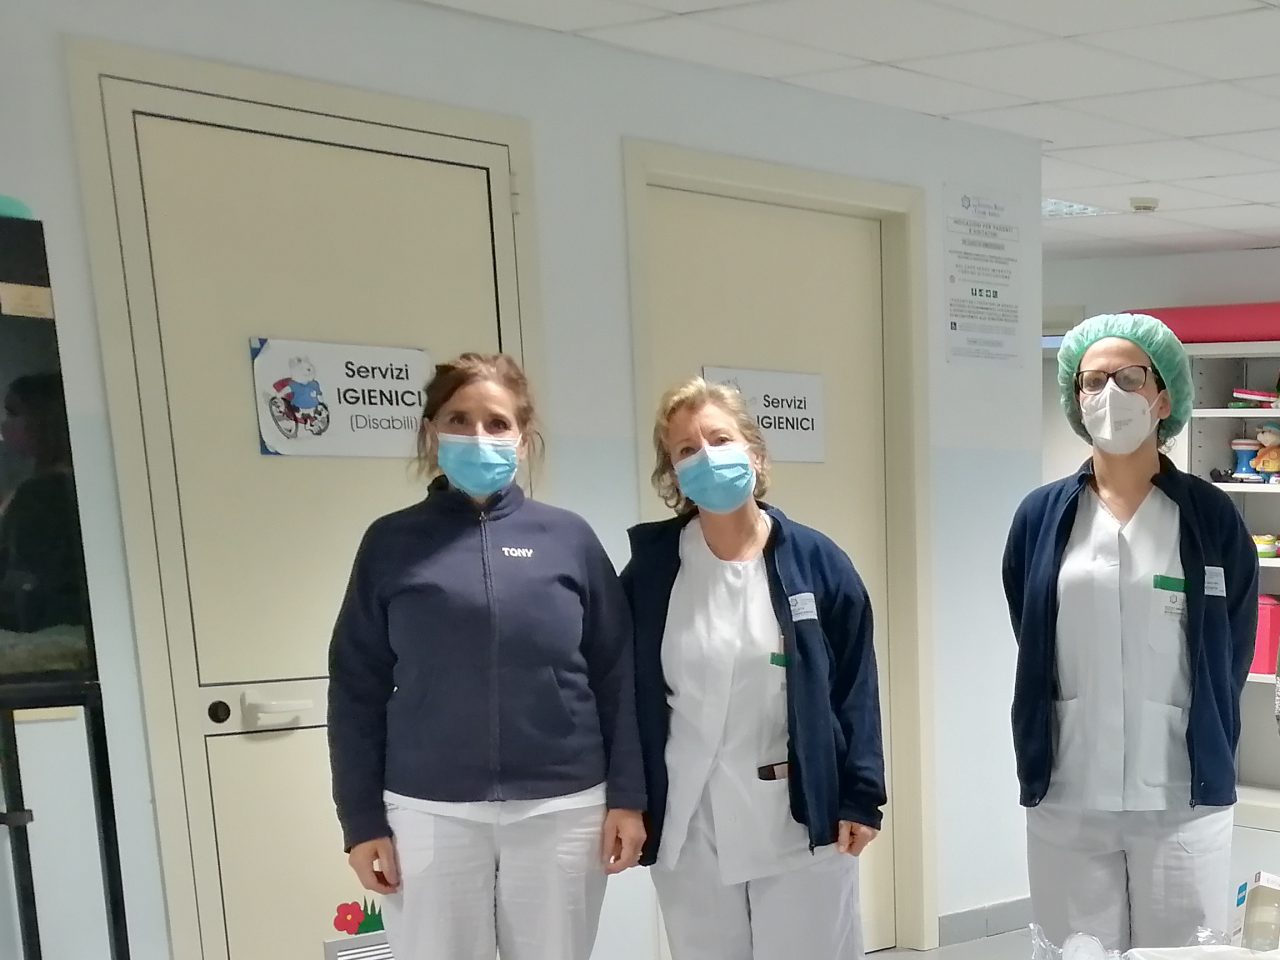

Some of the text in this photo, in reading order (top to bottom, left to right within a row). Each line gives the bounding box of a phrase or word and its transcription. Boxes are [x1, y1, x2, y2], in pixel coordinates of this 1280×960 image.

[344, 361, 409, 380] Servizi
[337, 387, 422, 407] IGIENICI
[763, 394, 807, 410] Servizi
[350, 414, 418, 432] (Disabili)
[757, 415, 815, 431] IGIENICI
[501, 547, 534, 557] TONY
